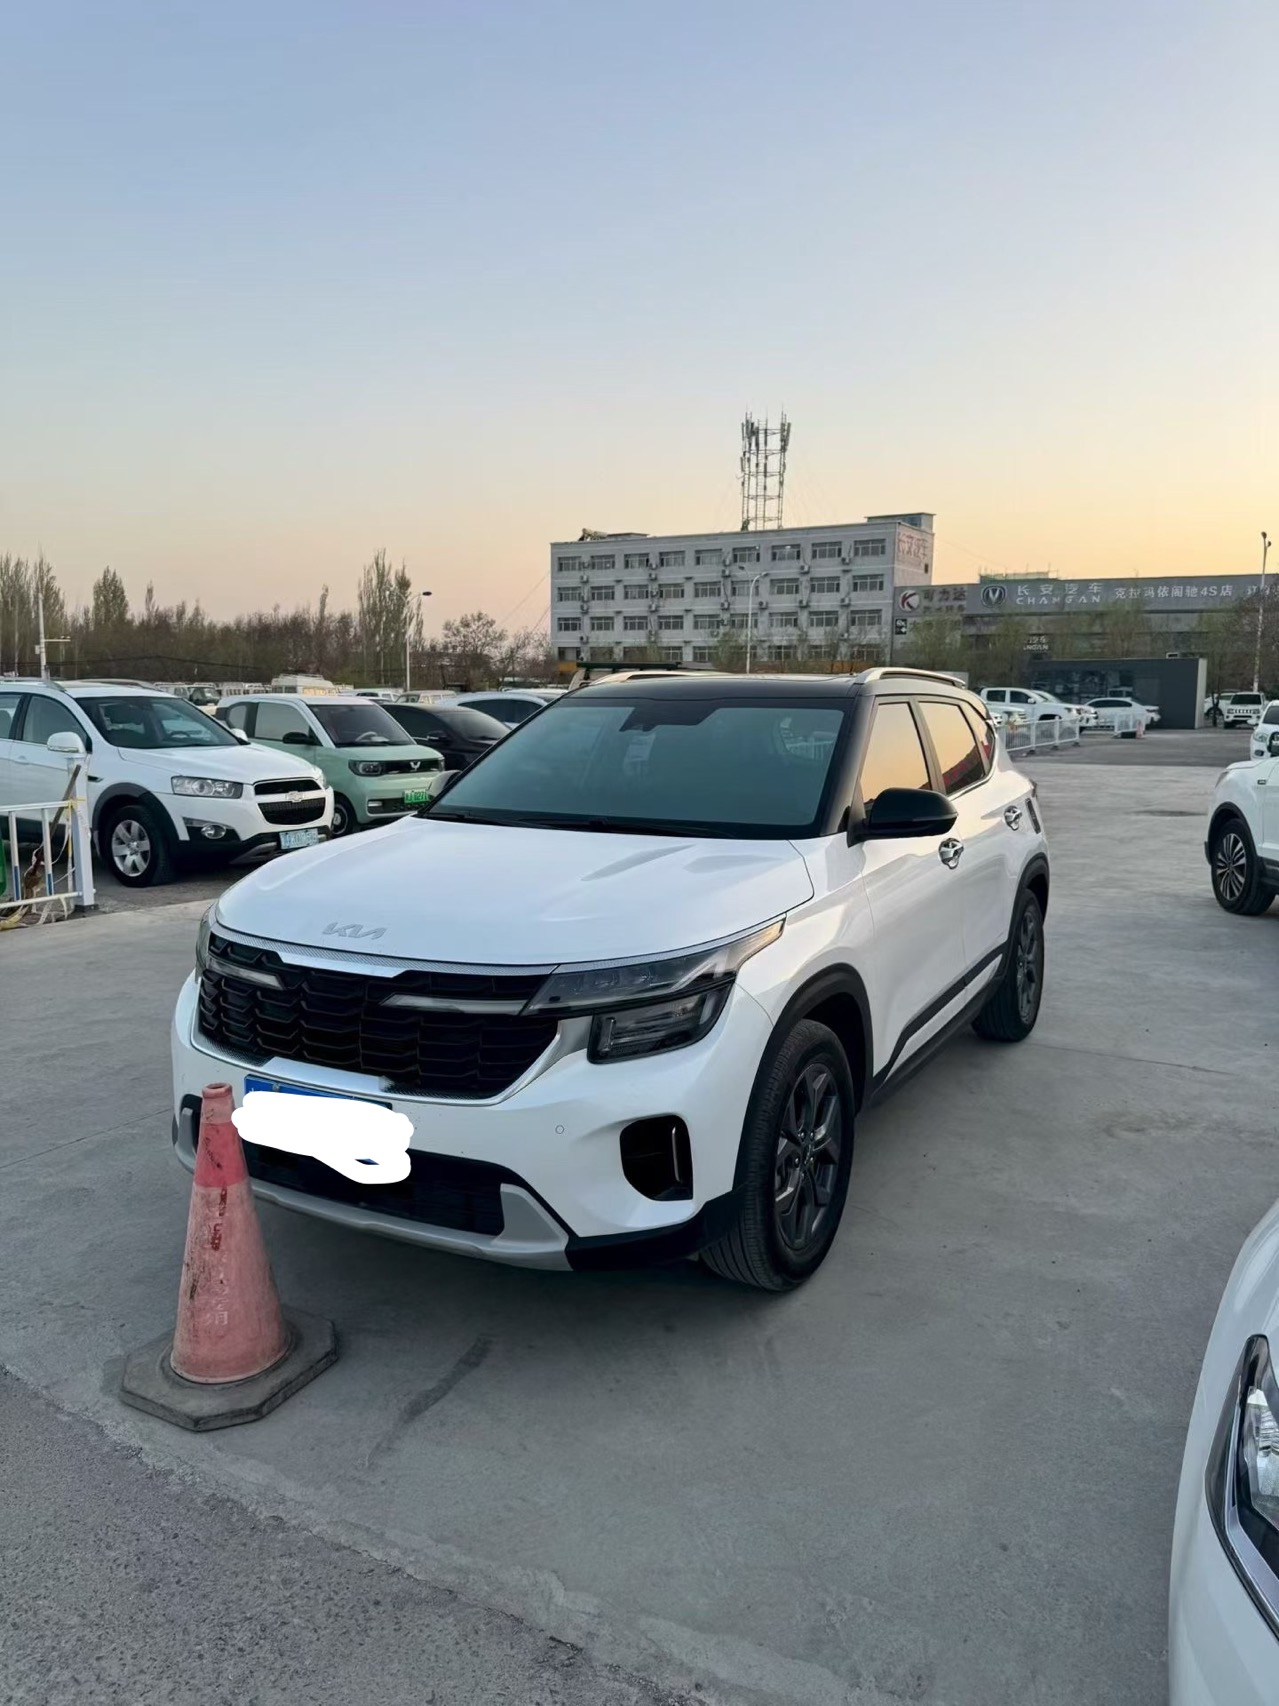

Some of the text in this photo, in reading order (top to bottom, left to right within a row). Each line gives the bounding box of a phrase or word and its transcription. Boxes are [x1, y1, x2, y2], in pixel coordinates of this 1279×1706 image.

[1017, 583, 1103, 597] 长安汽车
[1016, 595, 1101, 605] CHANGAN
[322, 921, 388, 940] KIA
